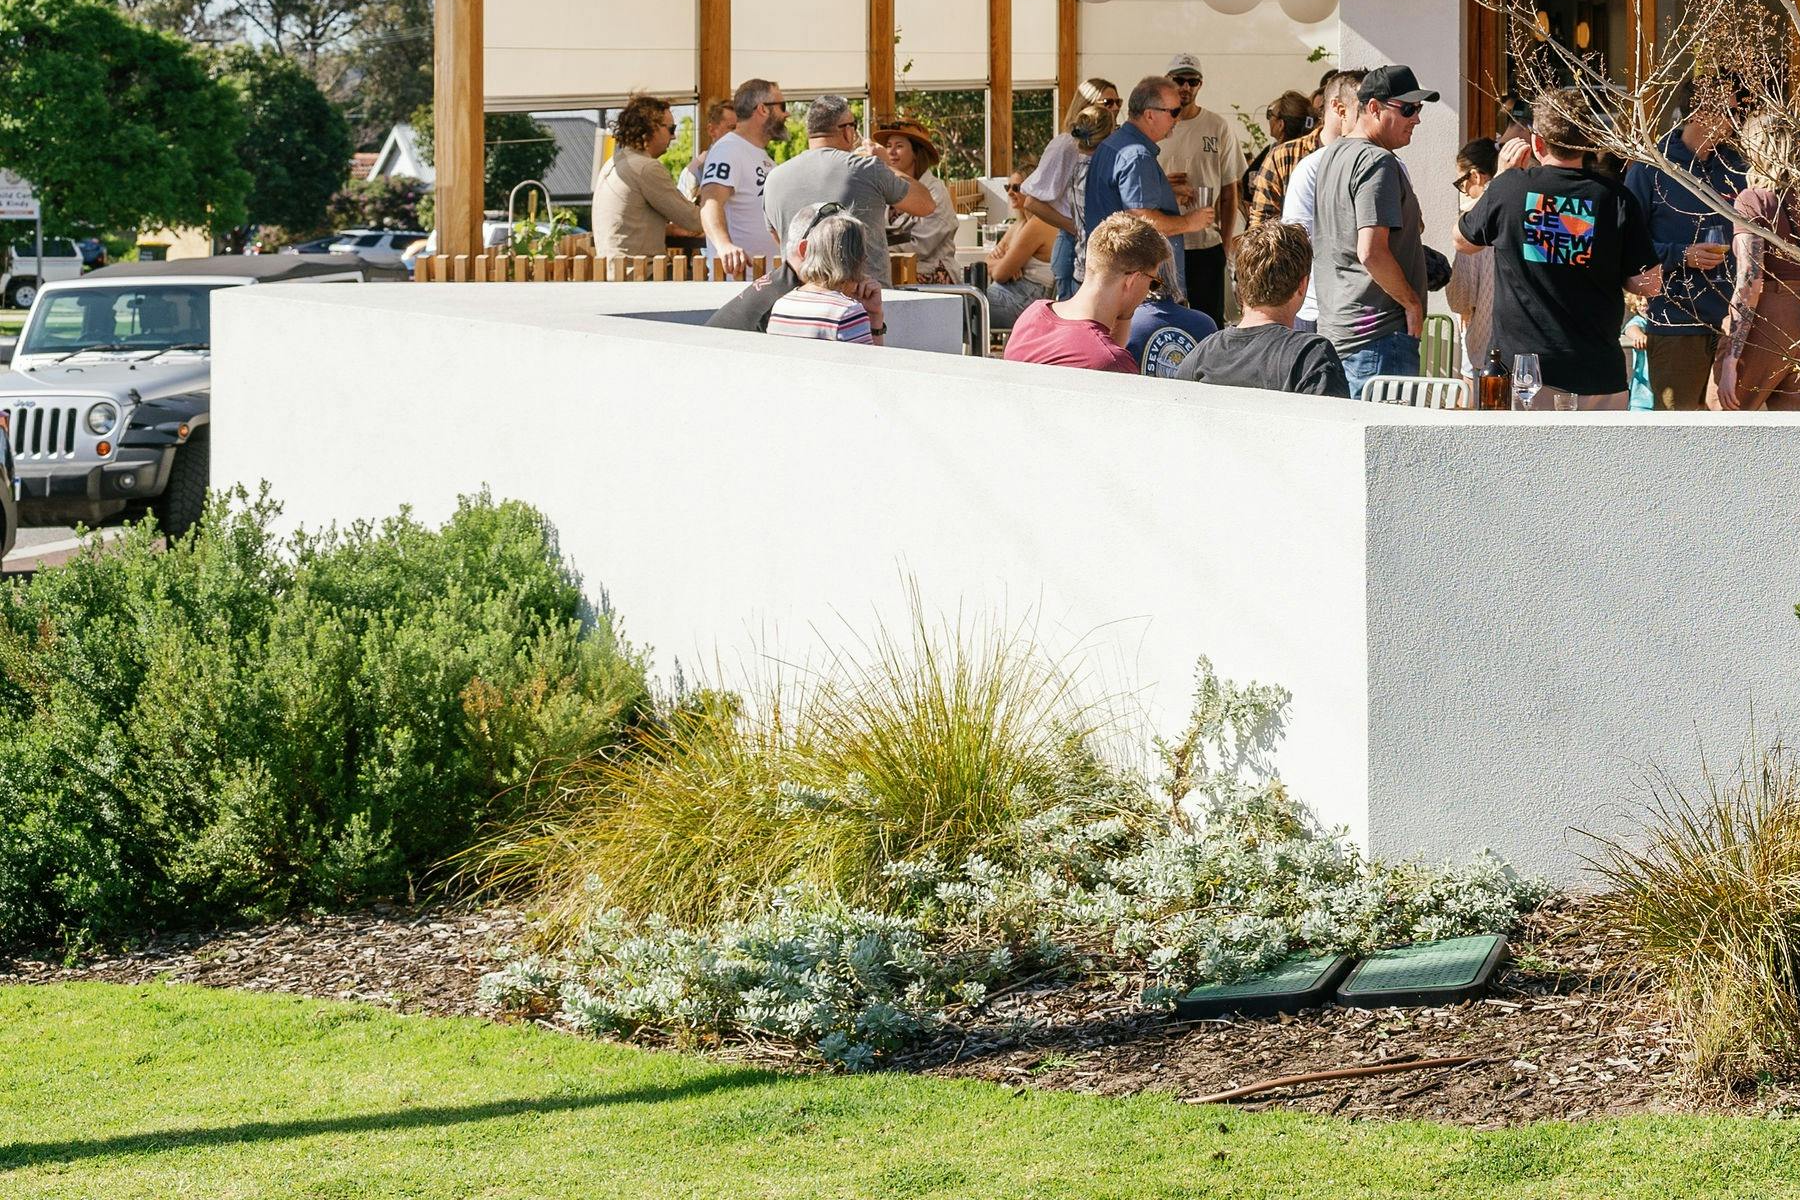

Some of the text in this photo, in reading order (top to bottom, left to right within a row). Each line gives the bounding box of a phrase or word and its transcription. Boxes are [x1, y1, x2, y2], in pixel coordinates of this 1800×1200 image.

[704, 162, 731, 180] 28
[1543, 193, 1595, 216] RAN
[1524, 208, 1560, 229] GE
[1523, 229, 1595, 252] BREW
[1546, 245, 1593, 266] ING
[1177, 336, 1193, 352] SE
